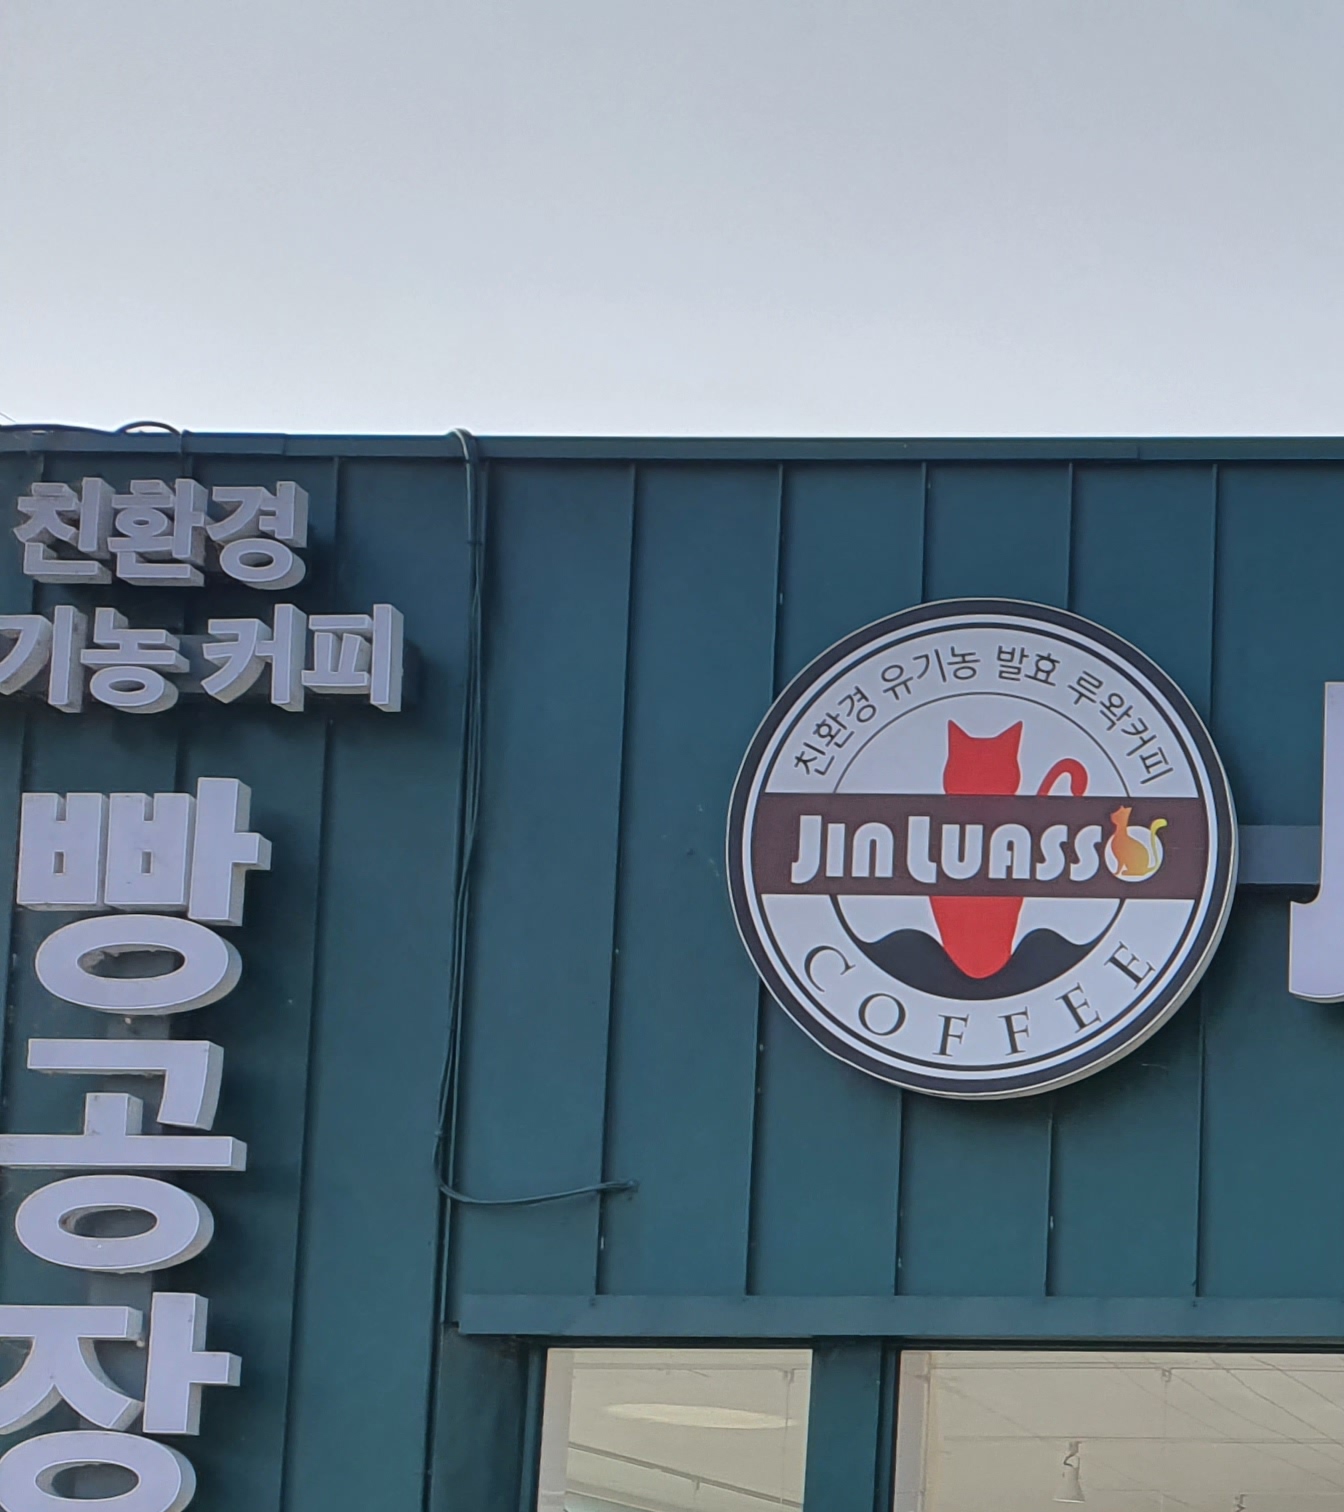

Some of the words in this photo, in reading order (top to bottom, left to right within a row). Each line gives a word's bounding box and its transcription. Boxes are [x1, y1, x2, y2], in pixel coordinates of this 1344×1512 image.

[14, 477, 309, 590] 친환경
[202, 603, 404, 712] 커피
[794, 684, 878, 776] 친환경
[880, 644, 981, 701] 유기농
[995, 644, 1061, 687] 발효
[1066, 675, 1175, 786] 루왁커피
[803, 940, 1156, 1057] COFFEE
